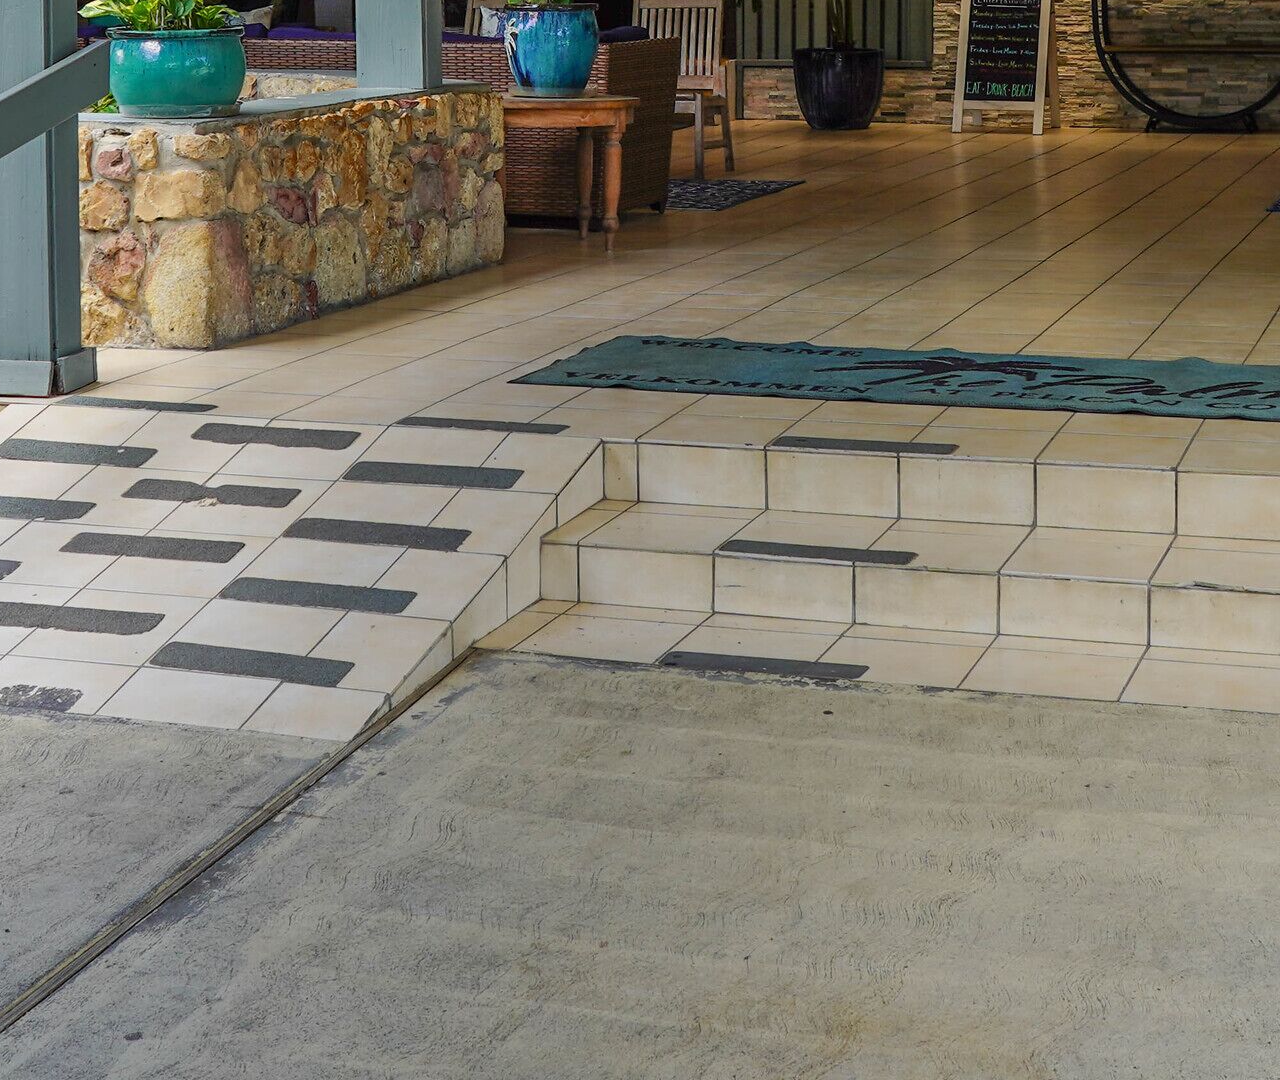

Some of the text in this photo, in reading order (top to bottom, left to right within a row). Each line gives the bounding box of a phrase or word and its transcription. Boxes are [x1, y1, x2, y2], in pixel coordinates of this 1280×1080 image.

[966, 81, 1034, 98] EAT DRINK BEACH
[640, 339, 864, 358] WELCOME
[564, 371, 872, 394] VELKOMMEN
[908, 388, 972, 396] AT
[990, 391, 1183, 406] PELICAN
